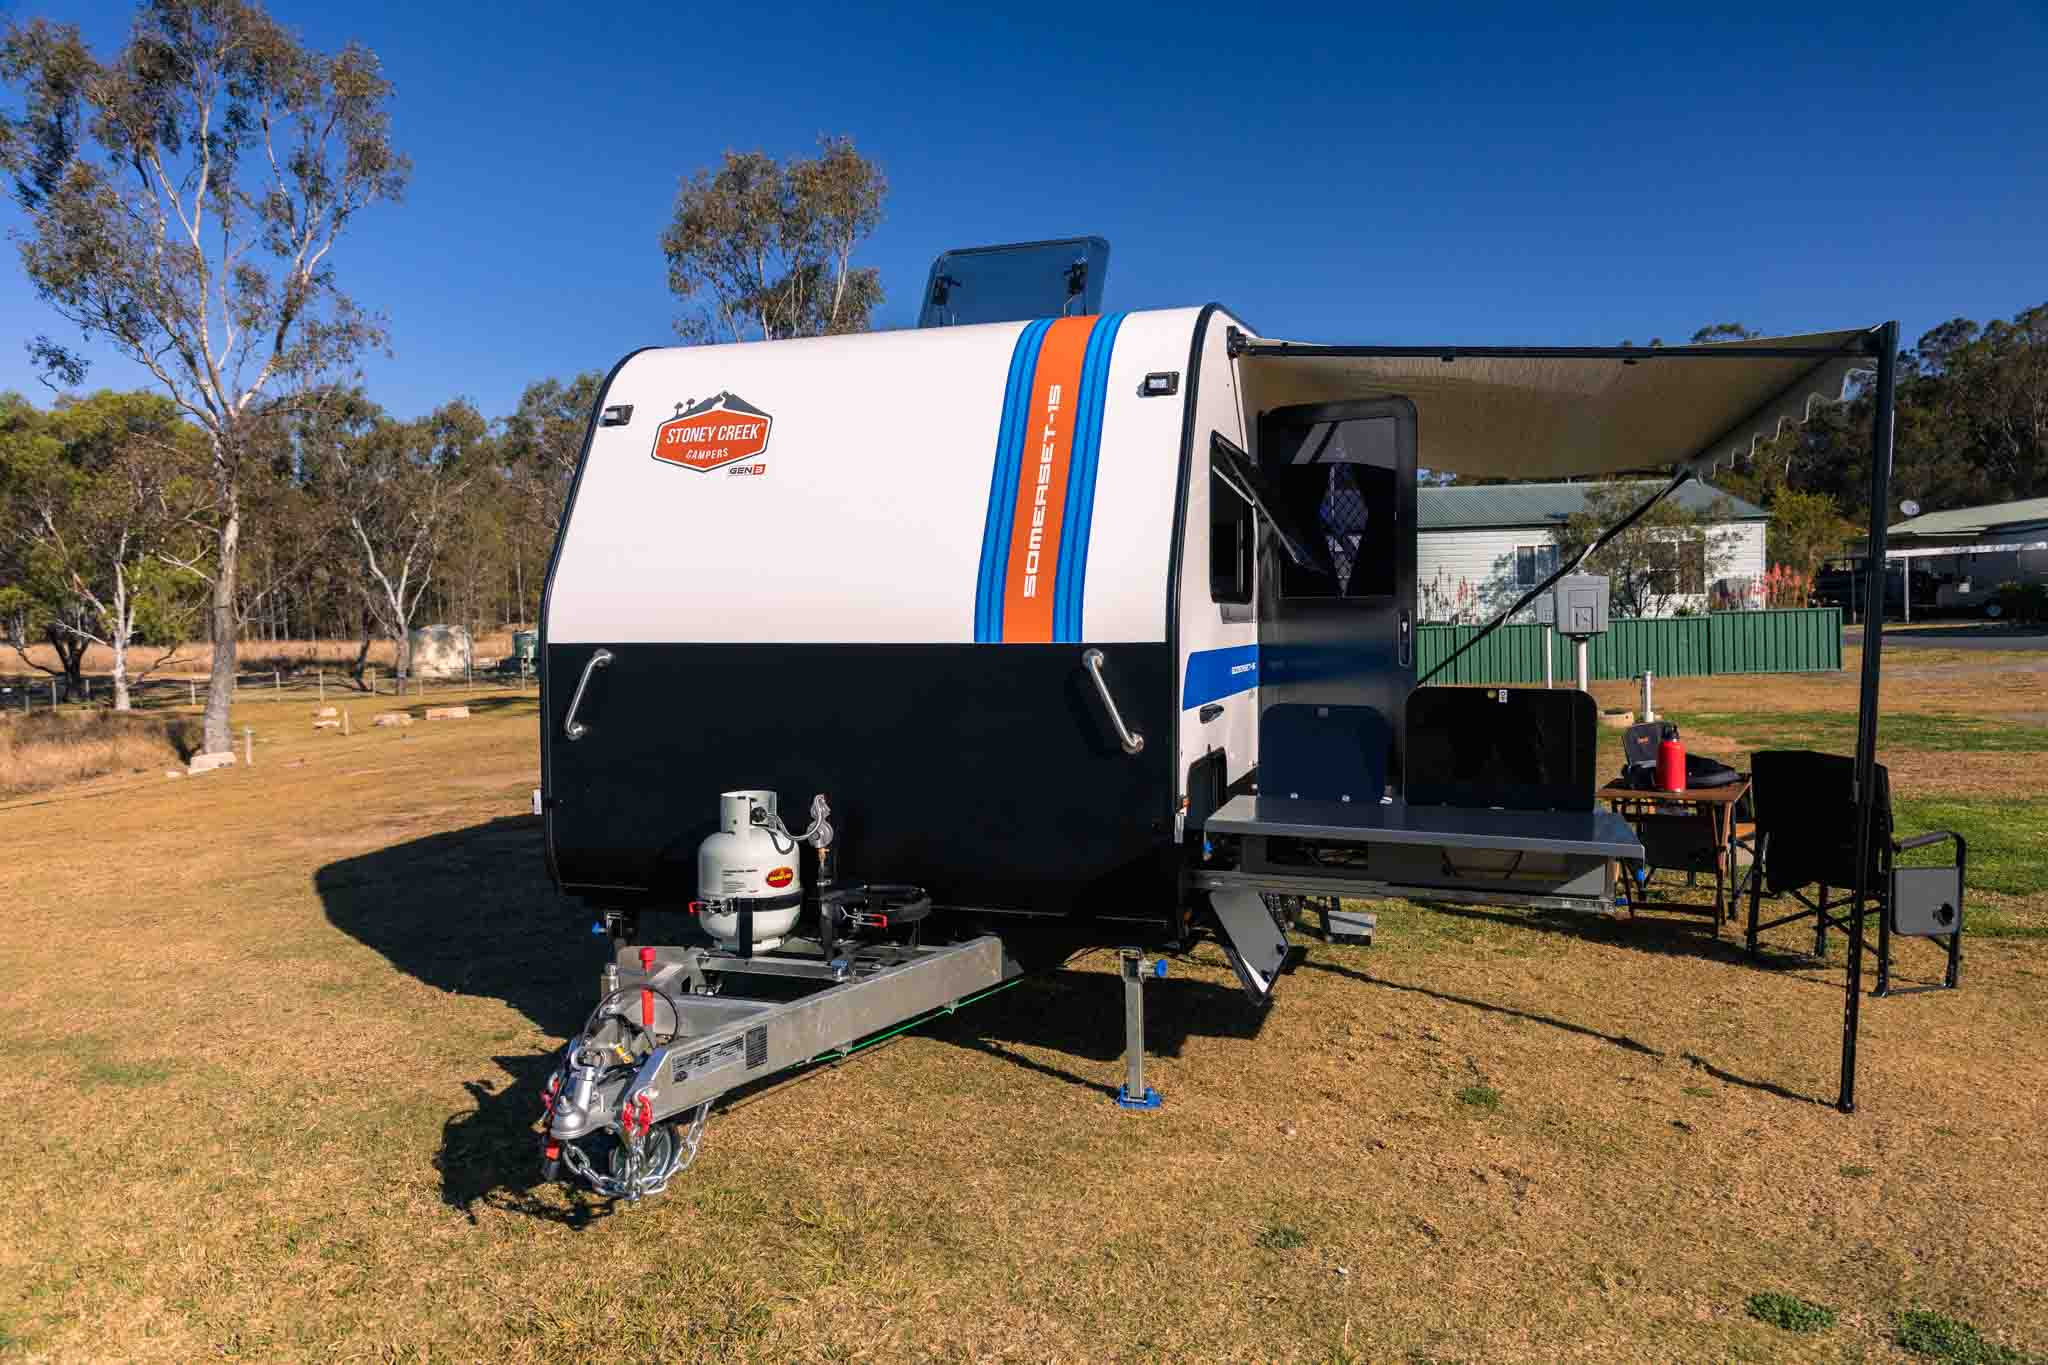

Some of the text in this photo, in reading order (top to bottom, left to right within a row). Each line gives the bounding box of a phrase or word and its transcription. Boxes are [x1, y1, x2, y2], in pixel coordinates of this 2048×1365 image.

[666, 423, 760, 444] STONEY CREEK
[686, 448, 729, 460] CAMPERS
[1023, 384, 1061, 598] SOMERSET-15
